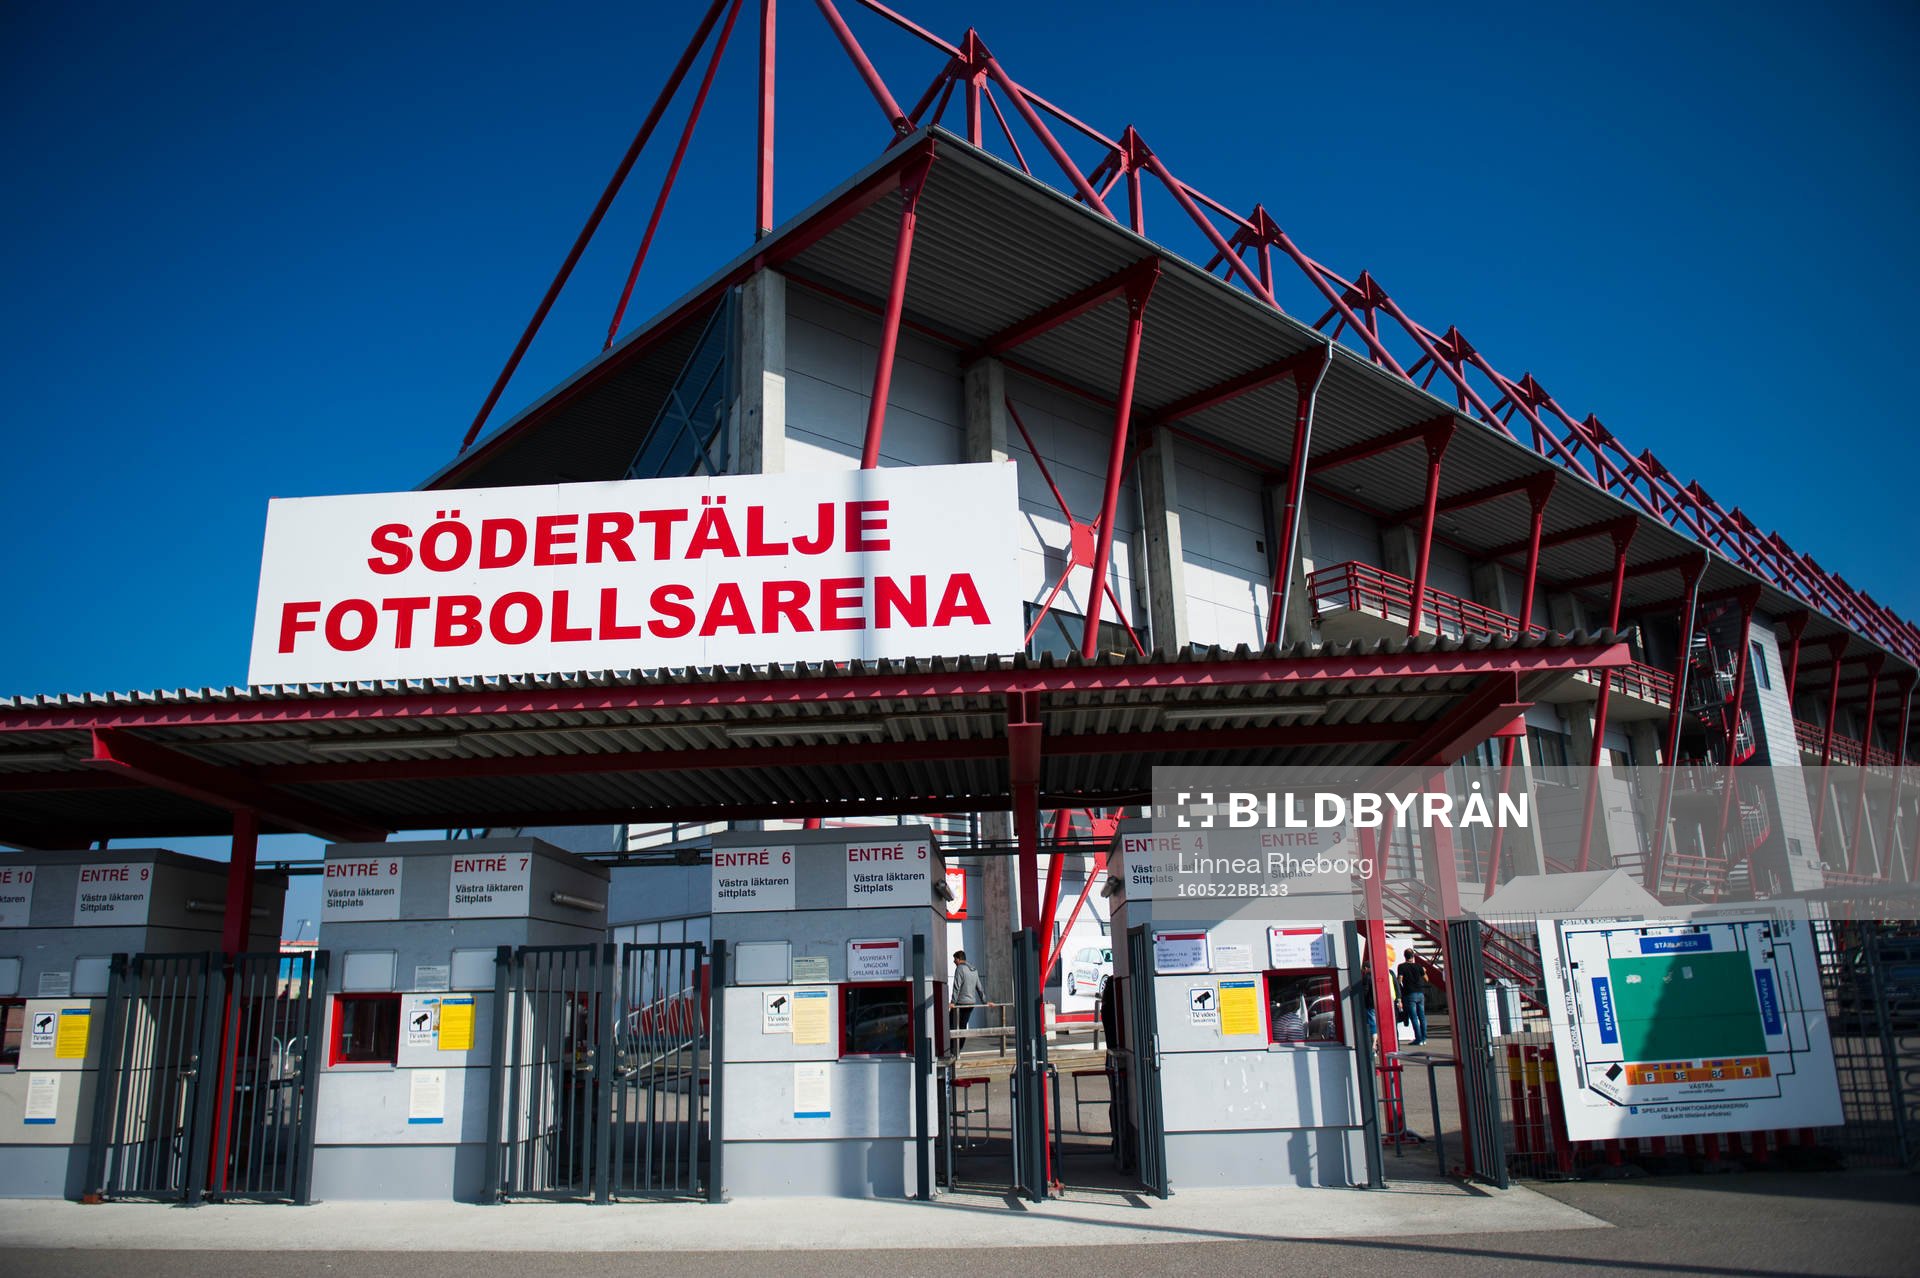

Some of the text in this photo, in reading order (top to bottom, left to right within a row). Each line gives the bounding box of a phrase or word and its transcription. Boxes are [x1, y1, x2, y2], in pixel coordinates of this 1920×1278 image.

[367, 495, 892, 576] SÖDERTÄLJE
[278, 572, 992, 655] FOTBOLLSARENA
[1125, 835, 1205, 853] ENTRÉ 4
[1261, 830, 1344, 848] ENTRÉ 3
[714, 849, 792, 867] ENTRÉ 6
[848, 844, 927, 862] ENTRÉ 5
[326, 860, 399, 878] ENTRÉ 8
[454, 856, 529, 873] ENTRÉ 7
[17, 871, 33, 884] 10
[80, 865, 149, 882] ENTRÉ 9
[853, 872, 925, 883] Västra läktaren
[1132, 873, 1174, 885] Sittplats
[455, 883, 524, 893] Västra läktaren
[718, 877, 789, 888] Västra läktaren
[853, 882, 894, 894] Sittplats
[81, 892, 144, 902] Västra läktaren
[327, 887, 395, 898] Västra läktaren
[454, 893, 493, 904] Sittplats
[718, 889, 757, 900] sittplats
[80, 903, 114, 912] Sittplats
[327, 898, 364, 909] Sittplats
